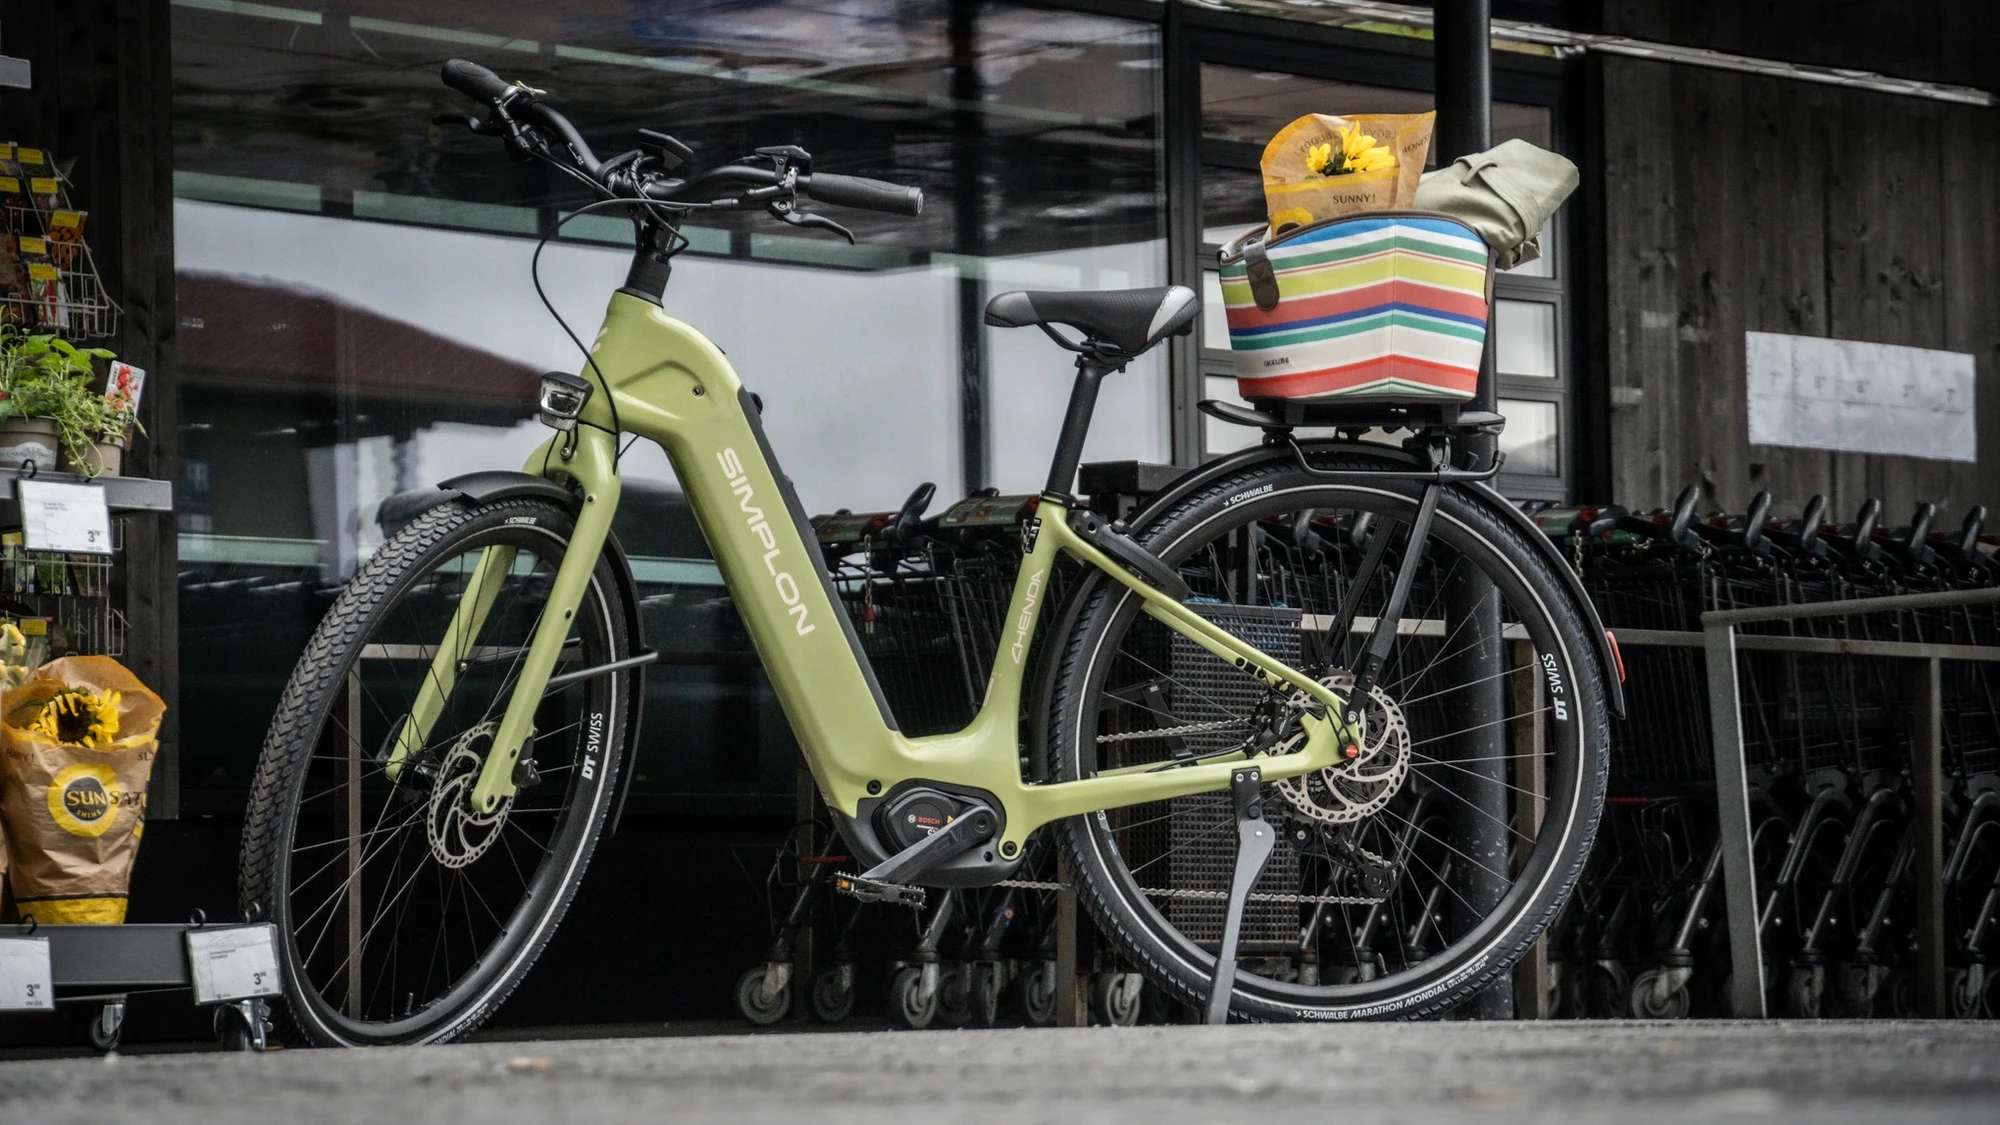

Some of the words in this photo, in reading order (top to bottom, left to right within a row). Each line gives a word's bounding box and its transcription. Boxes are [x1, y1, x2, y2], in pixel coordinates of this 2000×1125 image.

[1230, 484, 1273, 504] SCHWALBE
[716, 447, 815, 636] SIMPLON
[1012, 568, 1044, 664] CHENDA
[1541, 653, 1563, 693] SWISS
[1553, 697, 1567, 720] DT
[587, 713, 602, 753] SWISS
[581, 754, 596, 780] DT
[67, 790, 107, 805] SUN
[76, 809, 102, 818] SHINE
[918, 816, 940, 825] BOSCH
[1303, 1010, 1348, 1019] SCHWALBE
[1350, 1001, 1403, 1018] MARATHON
[1405, 983, 1448, 1007] MONDIAL
